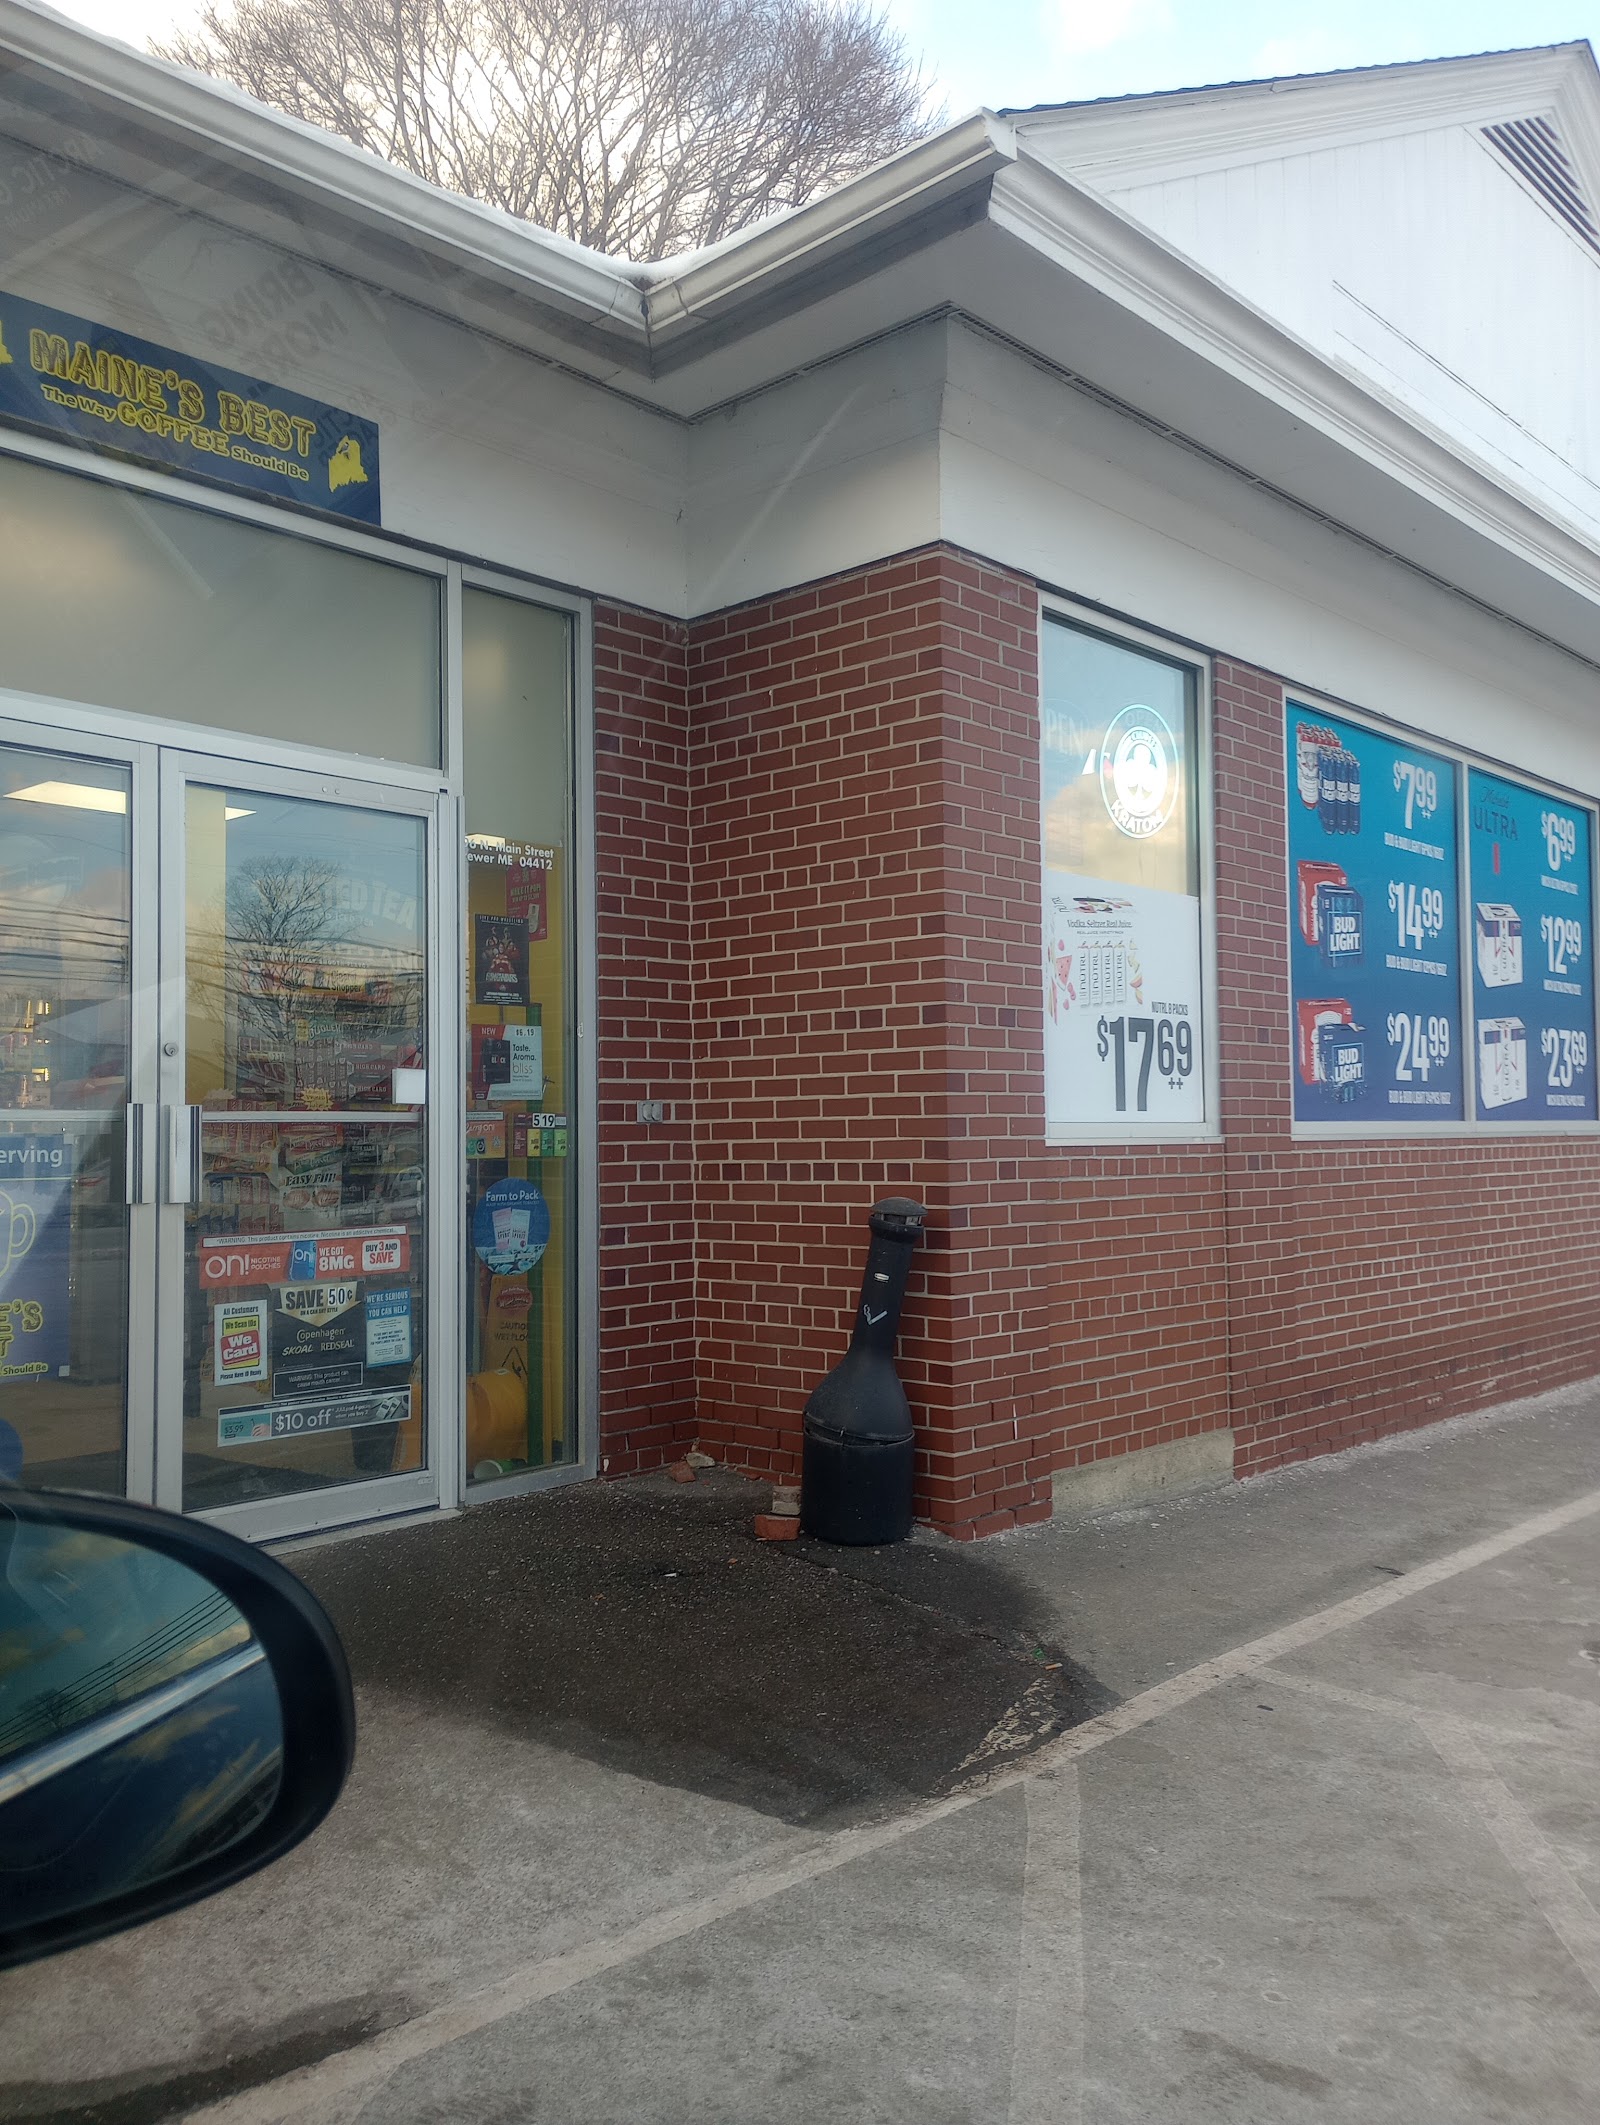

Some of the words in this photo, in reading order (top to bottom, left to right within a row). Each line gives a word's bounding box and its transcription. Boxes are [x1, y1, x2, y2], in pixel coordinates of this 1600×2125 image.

[29, 328, 205, 423] MAINE'S
[217, 390, 317, 458] BEST
[41, 383, 76, 408] The
[76, 396, 117, 424] Way
[116, 403, 231, 455] COFFEE
[231, 446, 287, 474] Should
[287, 460, 310, 482] Be
[1110, 798, 1165, 834] KRATOM
[1474, 807, 1518, 841] ULTRA
[480, 840, 492, 851] N.
[496, 842, 522, 856] Main
[525, 844, 554, 859] Street
[497, 855, 513, 866] ME
[519, 857, 553, 870] 04412
[1067, 919, 1086, 928] Vodka
[1086, 919, 1106, 928] Seltzer
[1106, 920, 1118, 928] Real
[1118, 920, 1132, 928] Juice
[1333, 916, 1356, 933] BUD
[1330, 933, 1360, 952] LIGHT
[1151, 1001, 1168, 1014] NUTRL
[1172, 1003, 1189, 1016] PACKS
[481, 1027, 496, 1035] NEW
[516, 1028, 536, 1037] $6.19
[512, 1044, 531, 1052] Taste.
[512, 1053, 537, 1061] Aroma.
[1337, 1048, 1359, 1065] BUD
[512, 1062, 533, 1075] bliss
[1334, 1063, 1363, 1082] LIGHT
[285, 1174, 313, 1187] Easy
[486, 1191, 508, 1202] Farm
[509, 1192, 519, 1201] to
[519, 1189, 539, 1201] Pack
[258, 1235, 278, 1243] product
[279, 1233, 299, 1241] contains
[320, 1230, 340, 1238] Nicotine
[352, 1228, 372, 1236] addictive
[319, 1247, 330, 1256] WE
[331, 1246, 345, 1255] GOT
[365, 1244, 378, 1252] BUY
[379, 1241, 384, 1251] 3
[384, 1243, 397, 1251] AND
[250, 1256, 281, 1264] NICOTINE
[319, 1255, 355, 1272] 8MG
[369, 1251, 394, 1264] SAVE
[205, 1254, 250, 1279] on!
[250, 1262, 281, 1270] POUCHES
[285, 1289, 324, 1310] SAVE
[366, 1294, 384, 1303] WE'RE
[385, 1291, 409, 1301] SERIOUS
[231, 1306, 259, 1315] Customers
[368, 1308, 380, 1317] YOU
[381, 1307, 392, 1316] CAN
[393, 1305, 407, 1314] HELP
[225, 1322, 233, 1330] We
[234, 1320, 247, 1328] Scan
[500, 1321, 528, 1331] CAUTIO
[228, 1334, 252, 1348] We
[296, 1328, 346, 1343] Copenhagen
[222, 1343, 258, 1361] Card
[282, 1344, 314, 1356] SKOAL
[3, 1364, 34, 1375] Should
[35, 1363, 47, 1372] Be
[323, 1371, 341, 1379] product
[274, 1413, 304, 1433] $10
